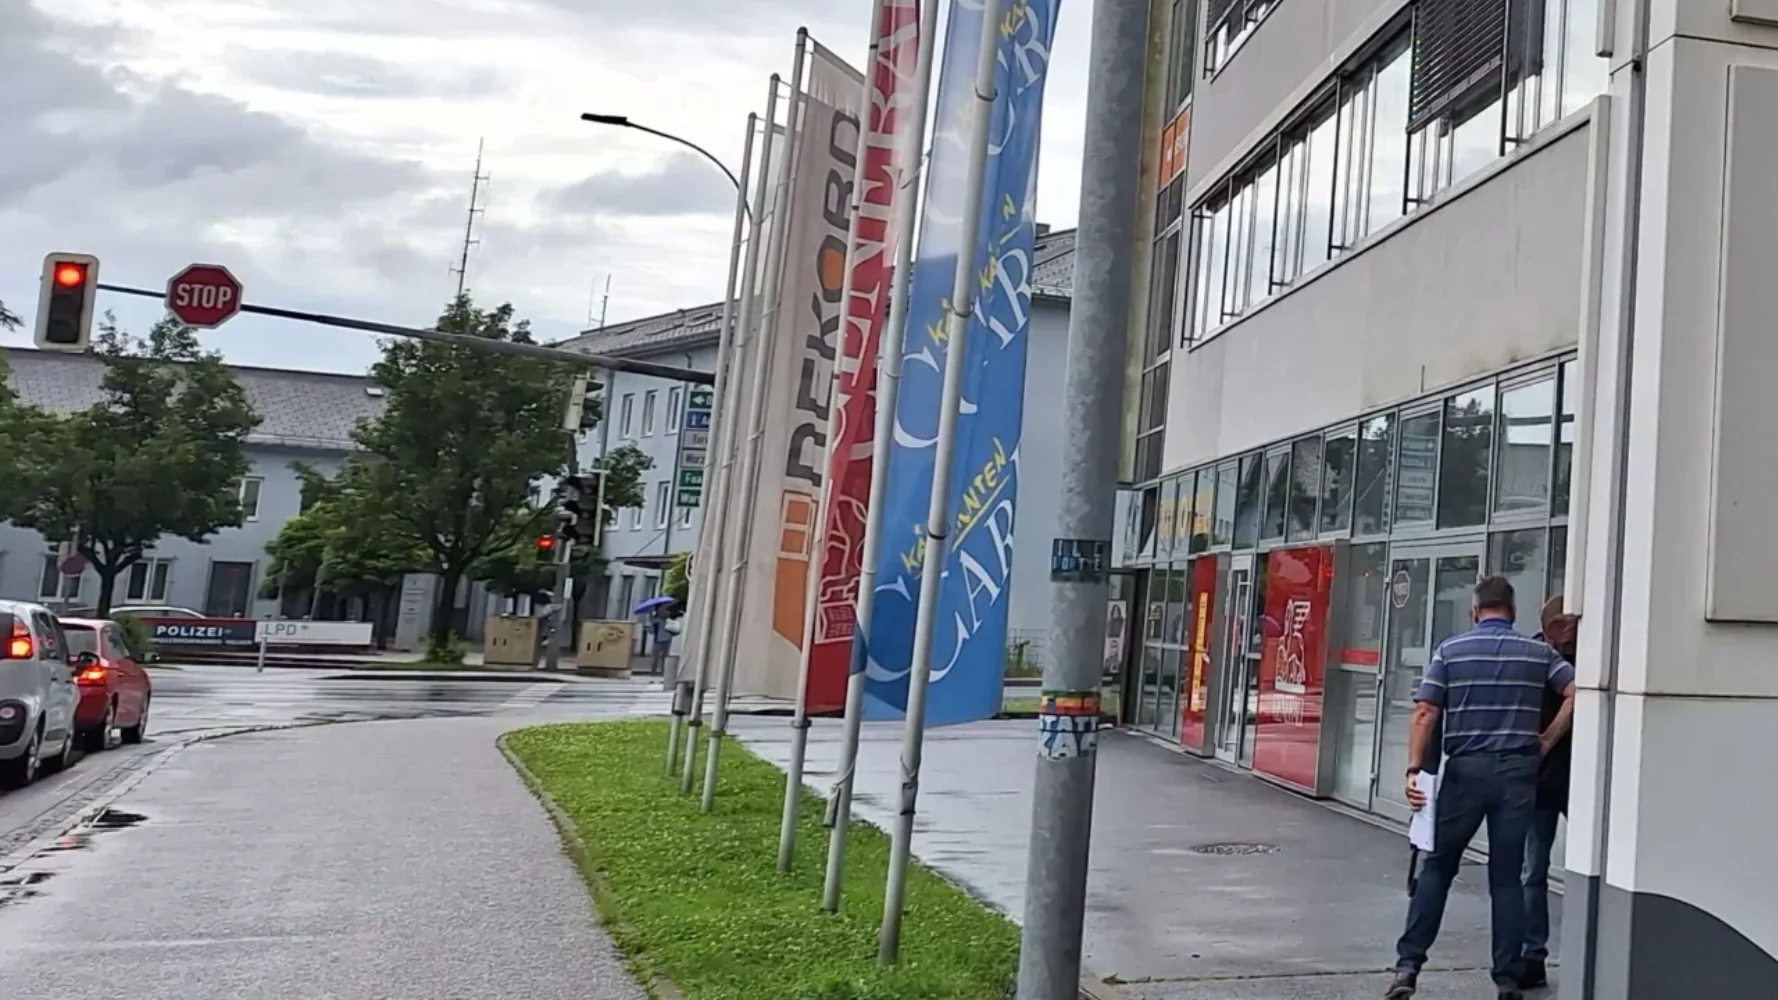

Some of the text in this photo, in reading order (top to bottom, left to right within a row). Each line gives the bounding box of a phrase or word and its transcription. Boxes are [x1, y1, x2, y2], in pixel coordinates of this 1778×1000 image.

[175, 282, 233, 310] STOP
[156, 625, 223, 638] POLIZEI
[264, 623, 297, 637] LPD
